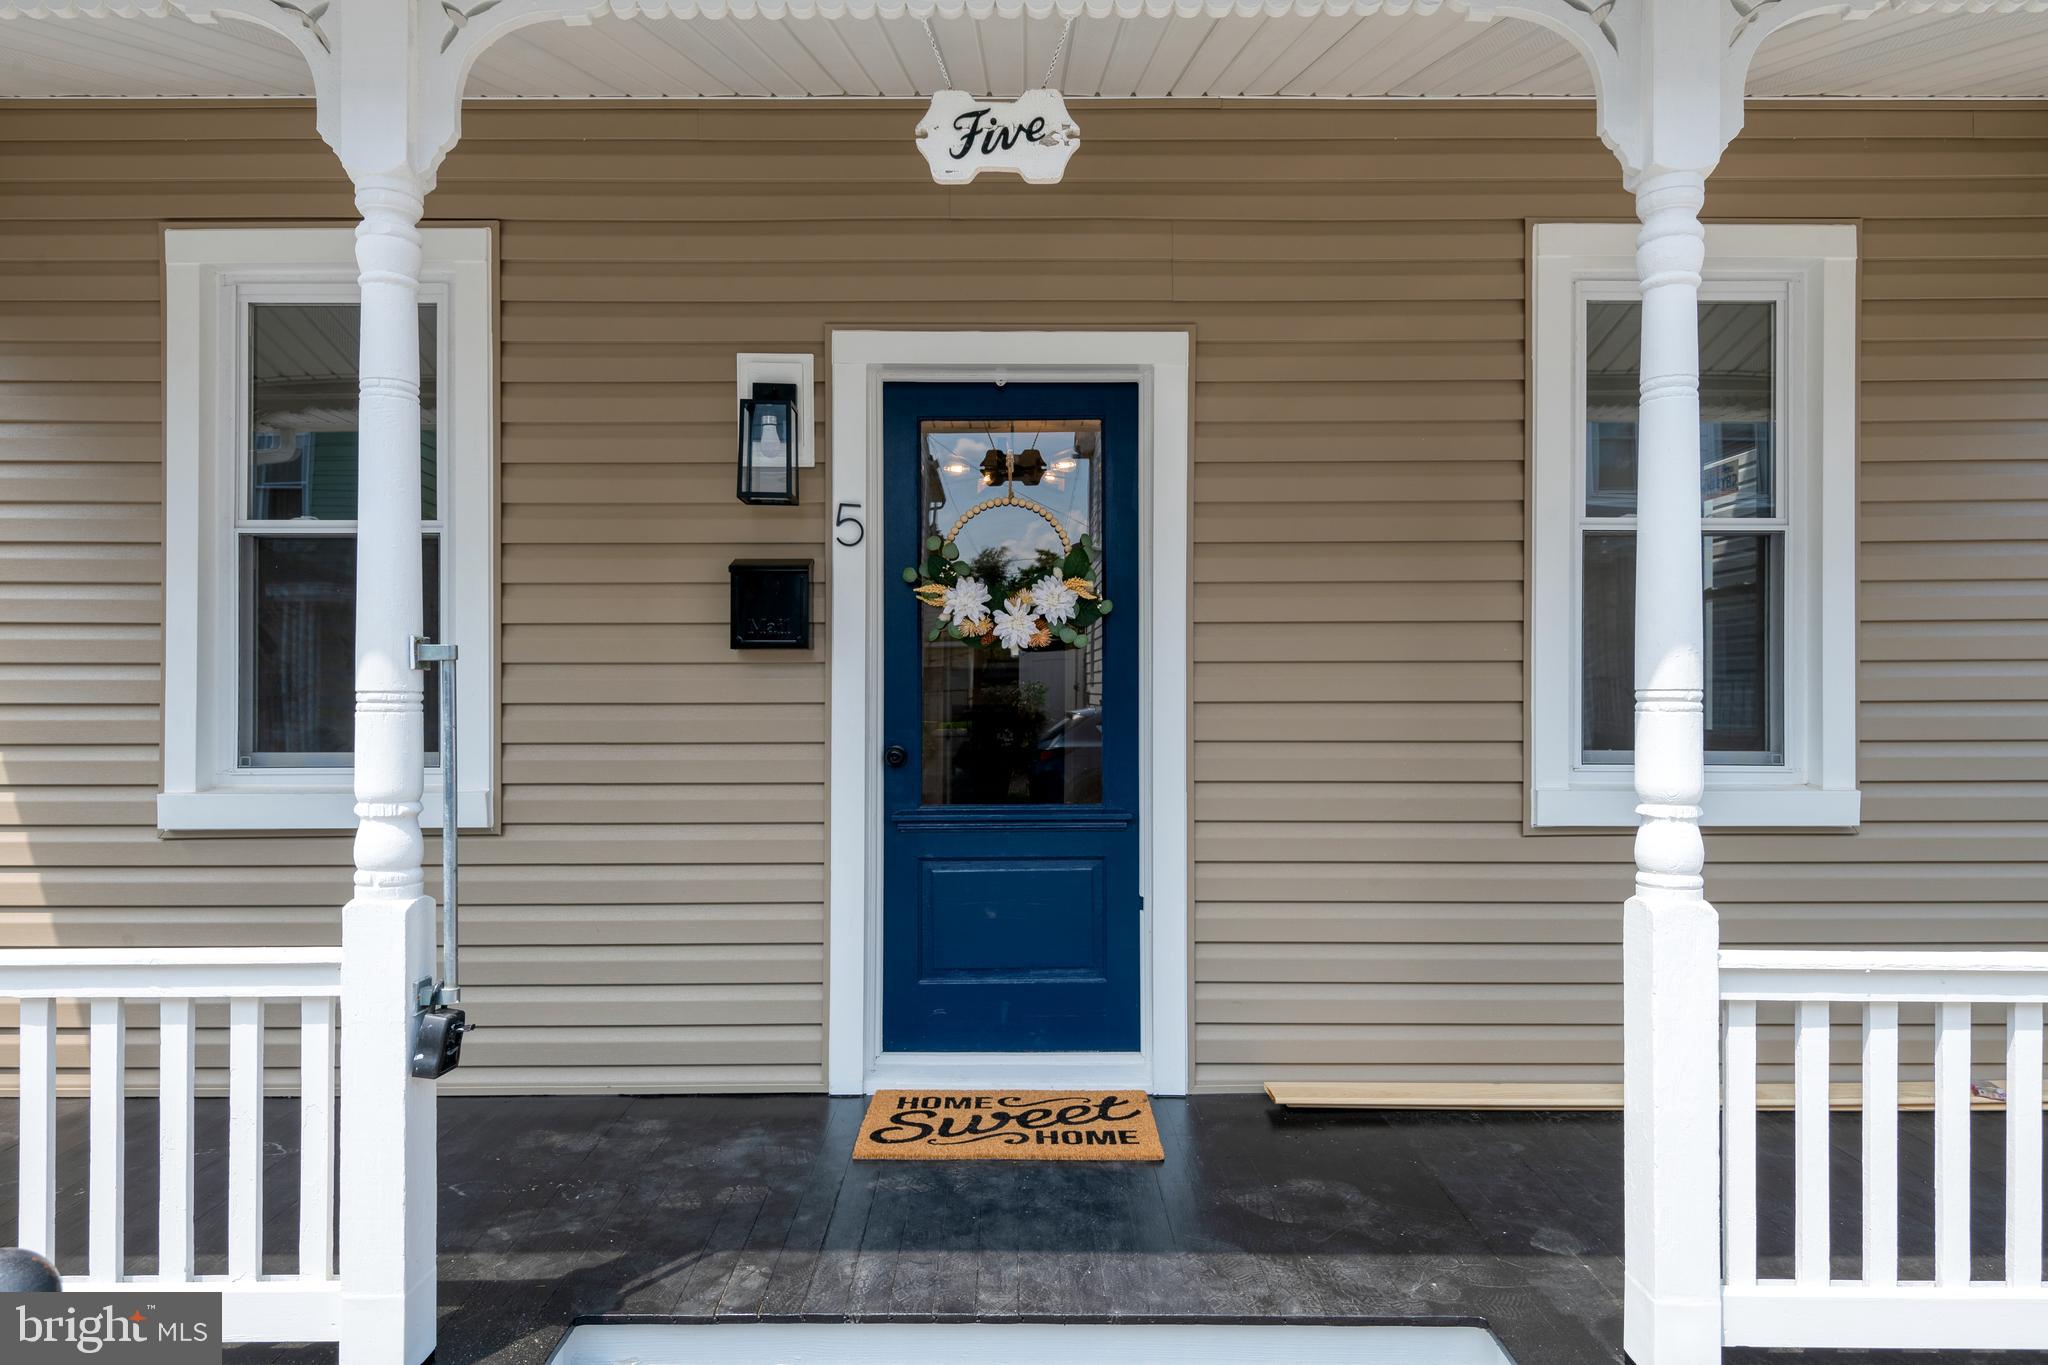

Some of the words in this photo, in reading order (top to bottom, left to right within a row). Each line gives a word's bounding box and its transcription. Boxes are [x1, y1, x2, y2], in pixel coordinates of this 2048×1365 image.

[949, 107, 1046, 160] Five
[835, 502, 865, 547] 5
[869, 1095, 1142, 1145] Sweet
[897, 1095, 993, 1110] HOME
[1036, 1129, 1140, 1145] HOME
